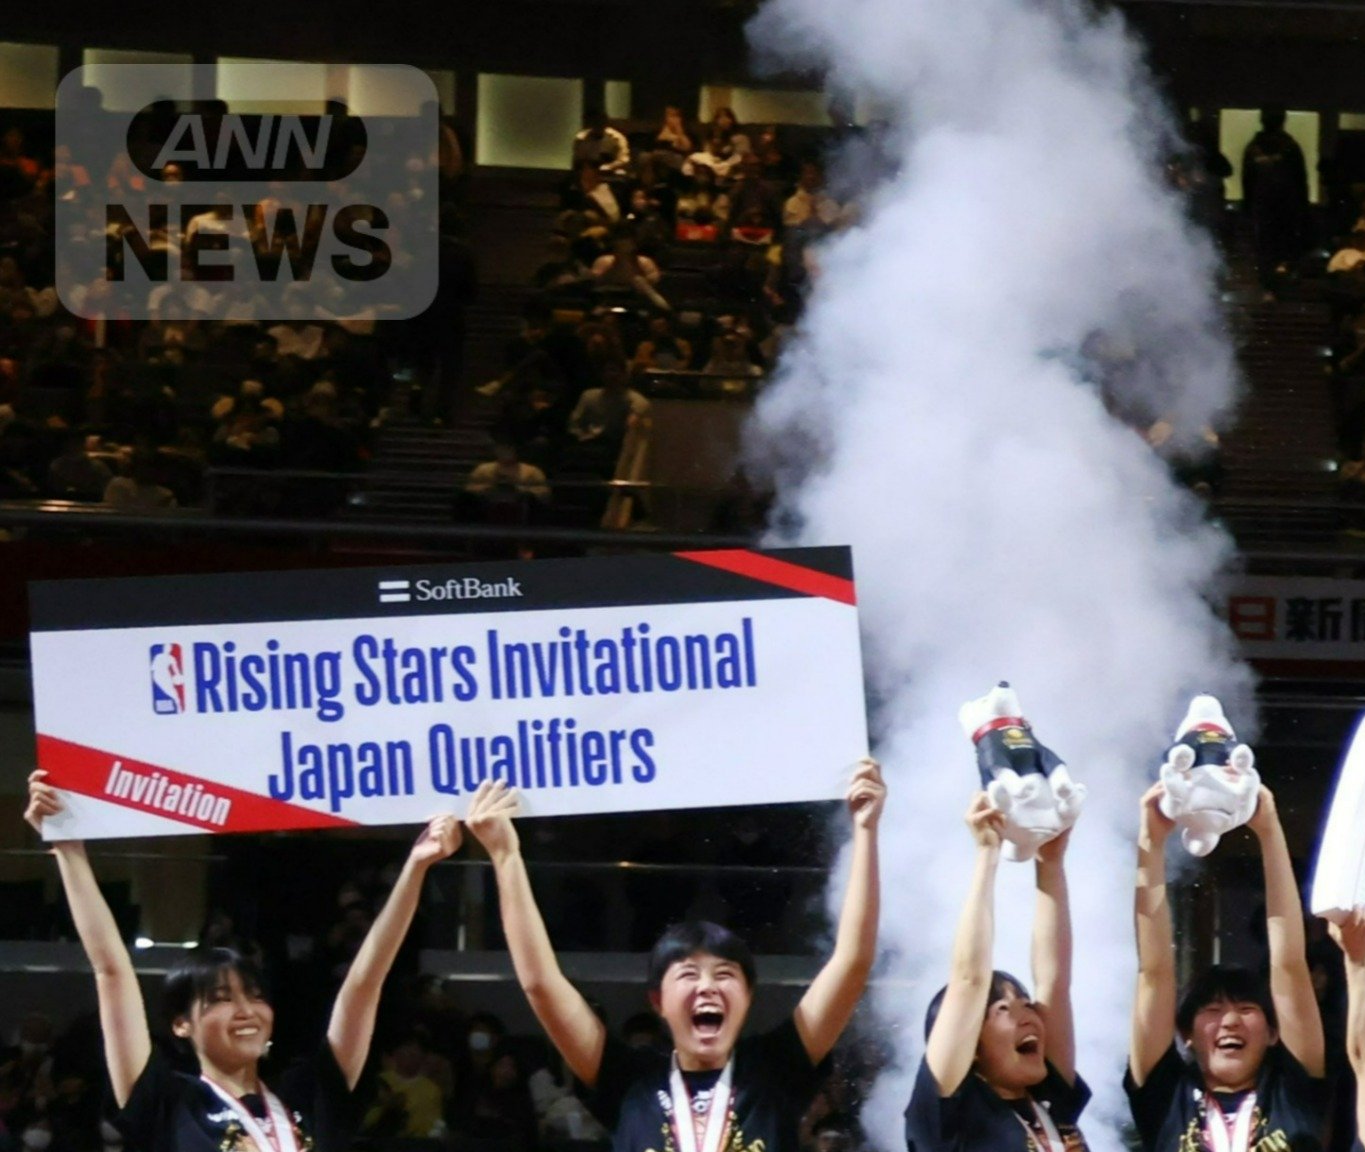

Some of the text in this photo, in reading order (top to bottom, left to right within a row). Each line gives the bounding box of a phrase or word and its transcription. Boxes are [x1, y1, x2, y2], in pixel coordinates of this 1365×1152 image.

[415, 577, 524, 601] SoftBank
[193, 617, 757, 723] Rising Stars Invitational
[104, 760, 232, 831] Invitation
[268, 717, 657, 812] Japan Qualifiers
